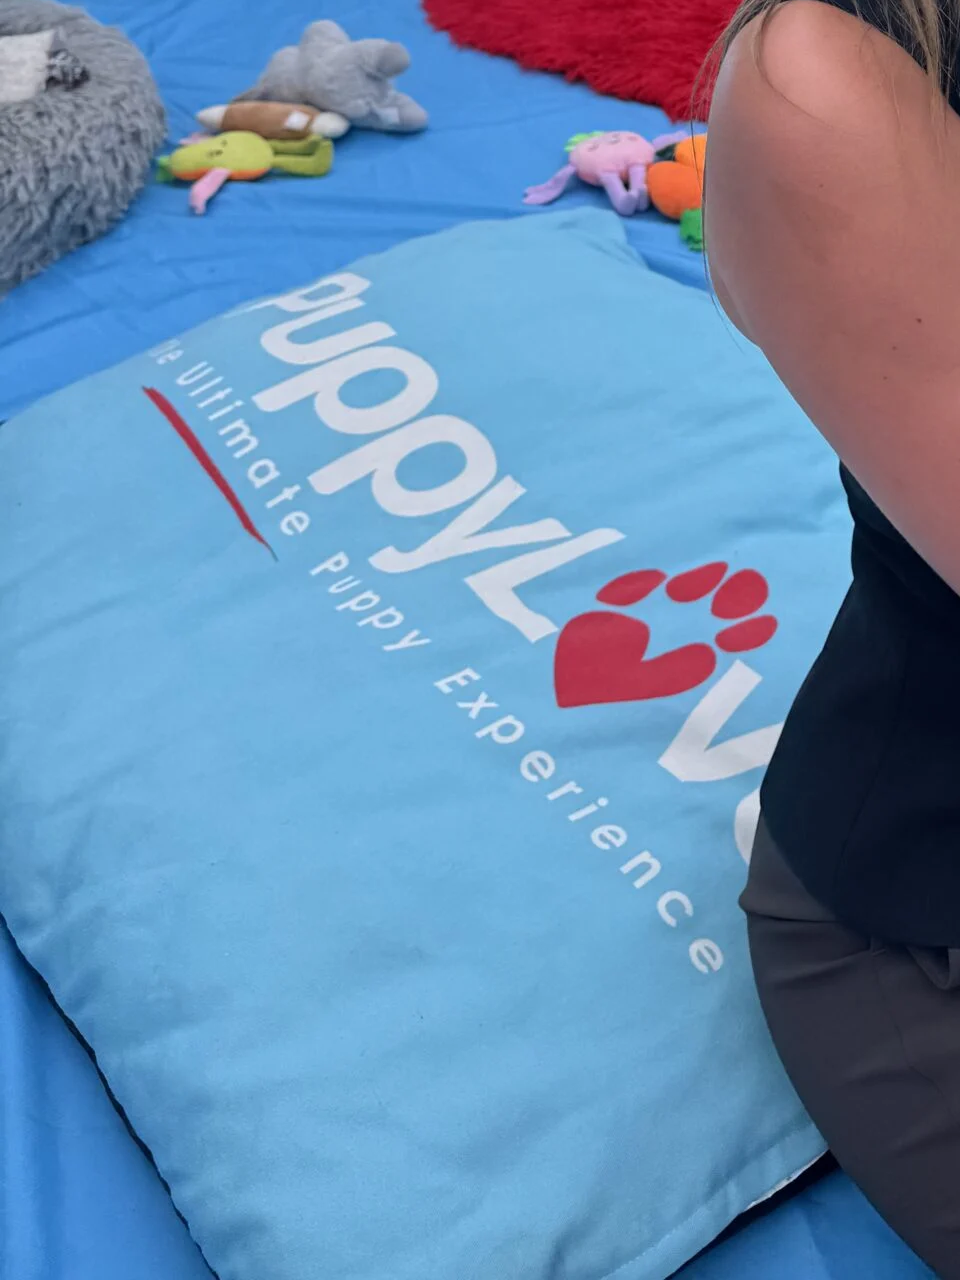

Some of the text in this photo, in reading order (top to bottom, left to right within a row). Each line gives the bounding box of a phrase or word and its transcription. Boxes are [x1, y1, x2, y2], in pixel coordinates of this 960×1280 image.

[175, 360, 311, 537] Ultimate
[309, 552, 431, 653] Puppy
[434, 667, 725, 975] Experience
